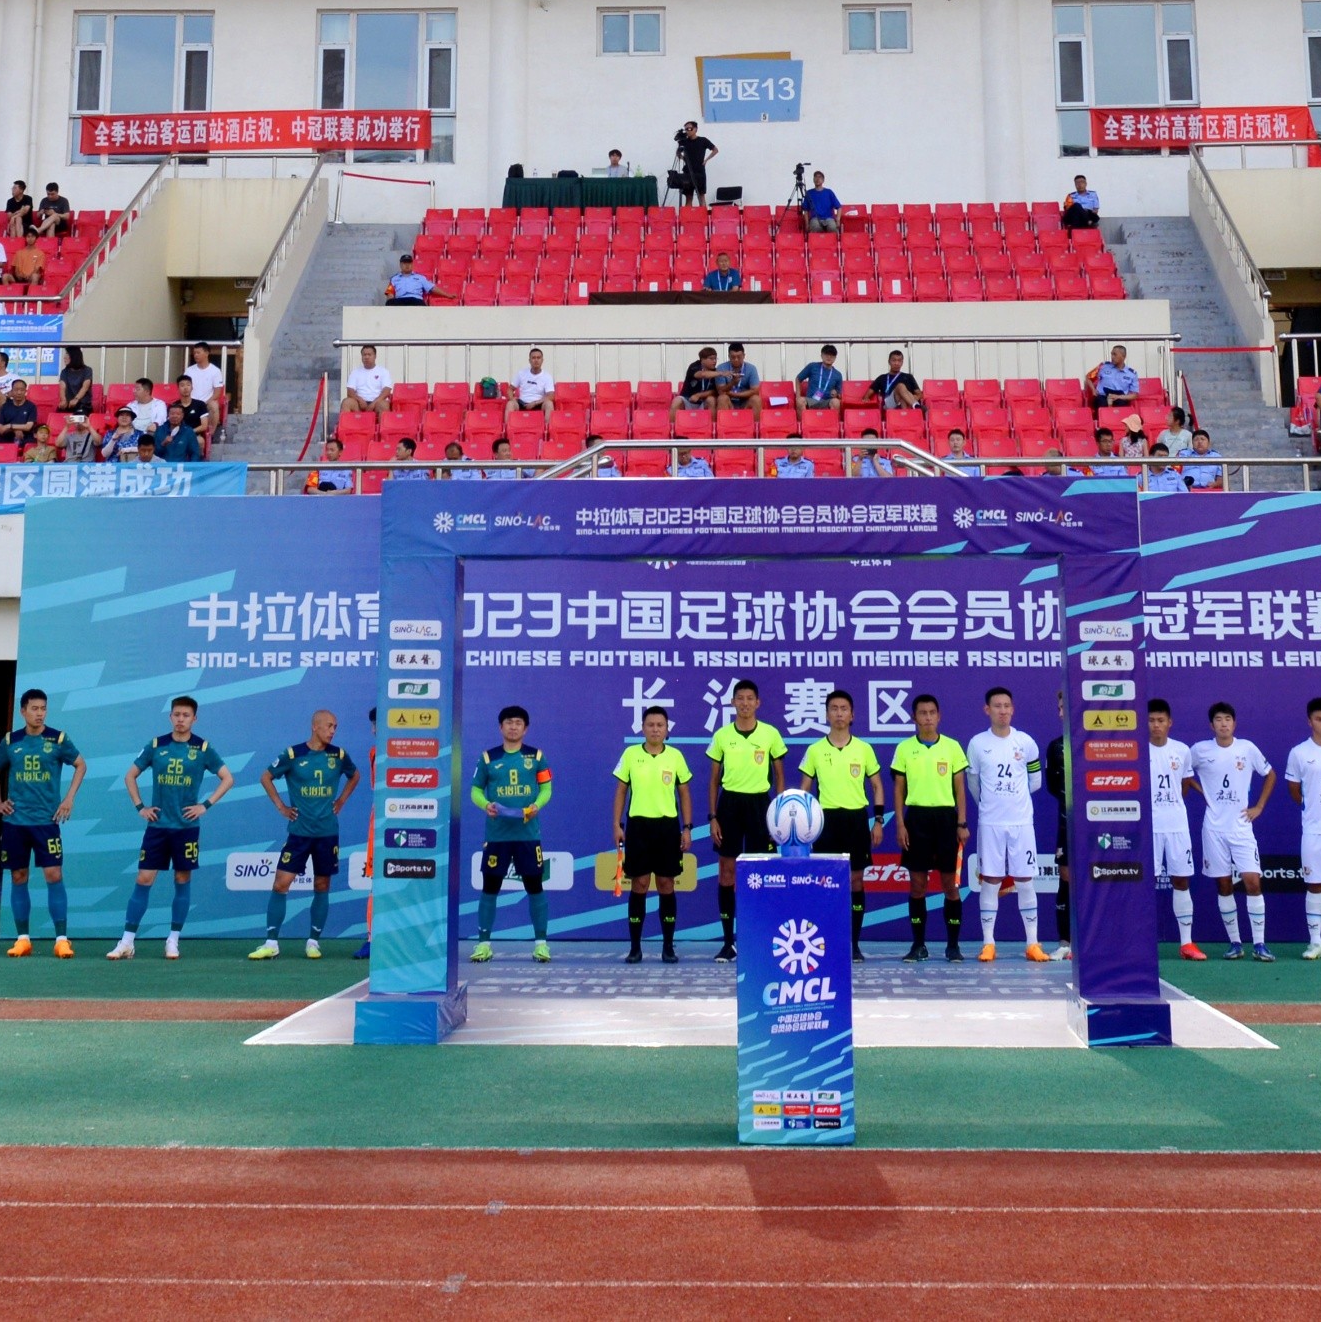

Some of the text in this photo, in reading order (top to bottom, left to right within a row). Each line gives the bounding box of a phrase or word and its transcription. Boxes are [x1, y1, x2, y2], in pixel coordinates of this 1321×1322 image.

[707, 78, 796, 103] 西区13
[291, 116, 421, 142] 中冠联赛成功举行
[456, 514, 486, 525] CMCL
[494, 515, 551, 527] SINO-LAC
[576, 505, 938, 527] 中拉体育2023中国足球协会会员协会冠军联赛
[976, 509, 1007, 520] CMCL
[1015, 510, 1073, 523] SINO-LAC
[187, 651, 292, 668] SINO-LAC
[466, 651, 561, 667] CHINESE
[570, 651, 685, 667] FOOTBALL
[693, 651, 843, 667] ASSOCIATION
[852, 650, 958, 667] MEMBER
[967, 650, 1062, 667] ASSOCIA
[1145, 651, 1263, 667] HAMPIONS
[24, 755, 40, 770] 66
[167, 758, 183, 775] 26
[314, 770, 323, 785] 7
[509, 769, 518, 785] 8
[997, 763, 1012, 778] 24
[1158, 774, 1171, 789] 21
[1222, 774, 1230, 788] 6
[47, 838, 62, 854] 66
[185, 842, 198, 859] 26
[535, 846, 542, 863] 8
[1185, 849, 1192, 864] 2
[764, 874, 786, 883] CMCL
[791, 875, 832, 885] SINO-LAC
[762, 977, 837, 1006] CMCL
